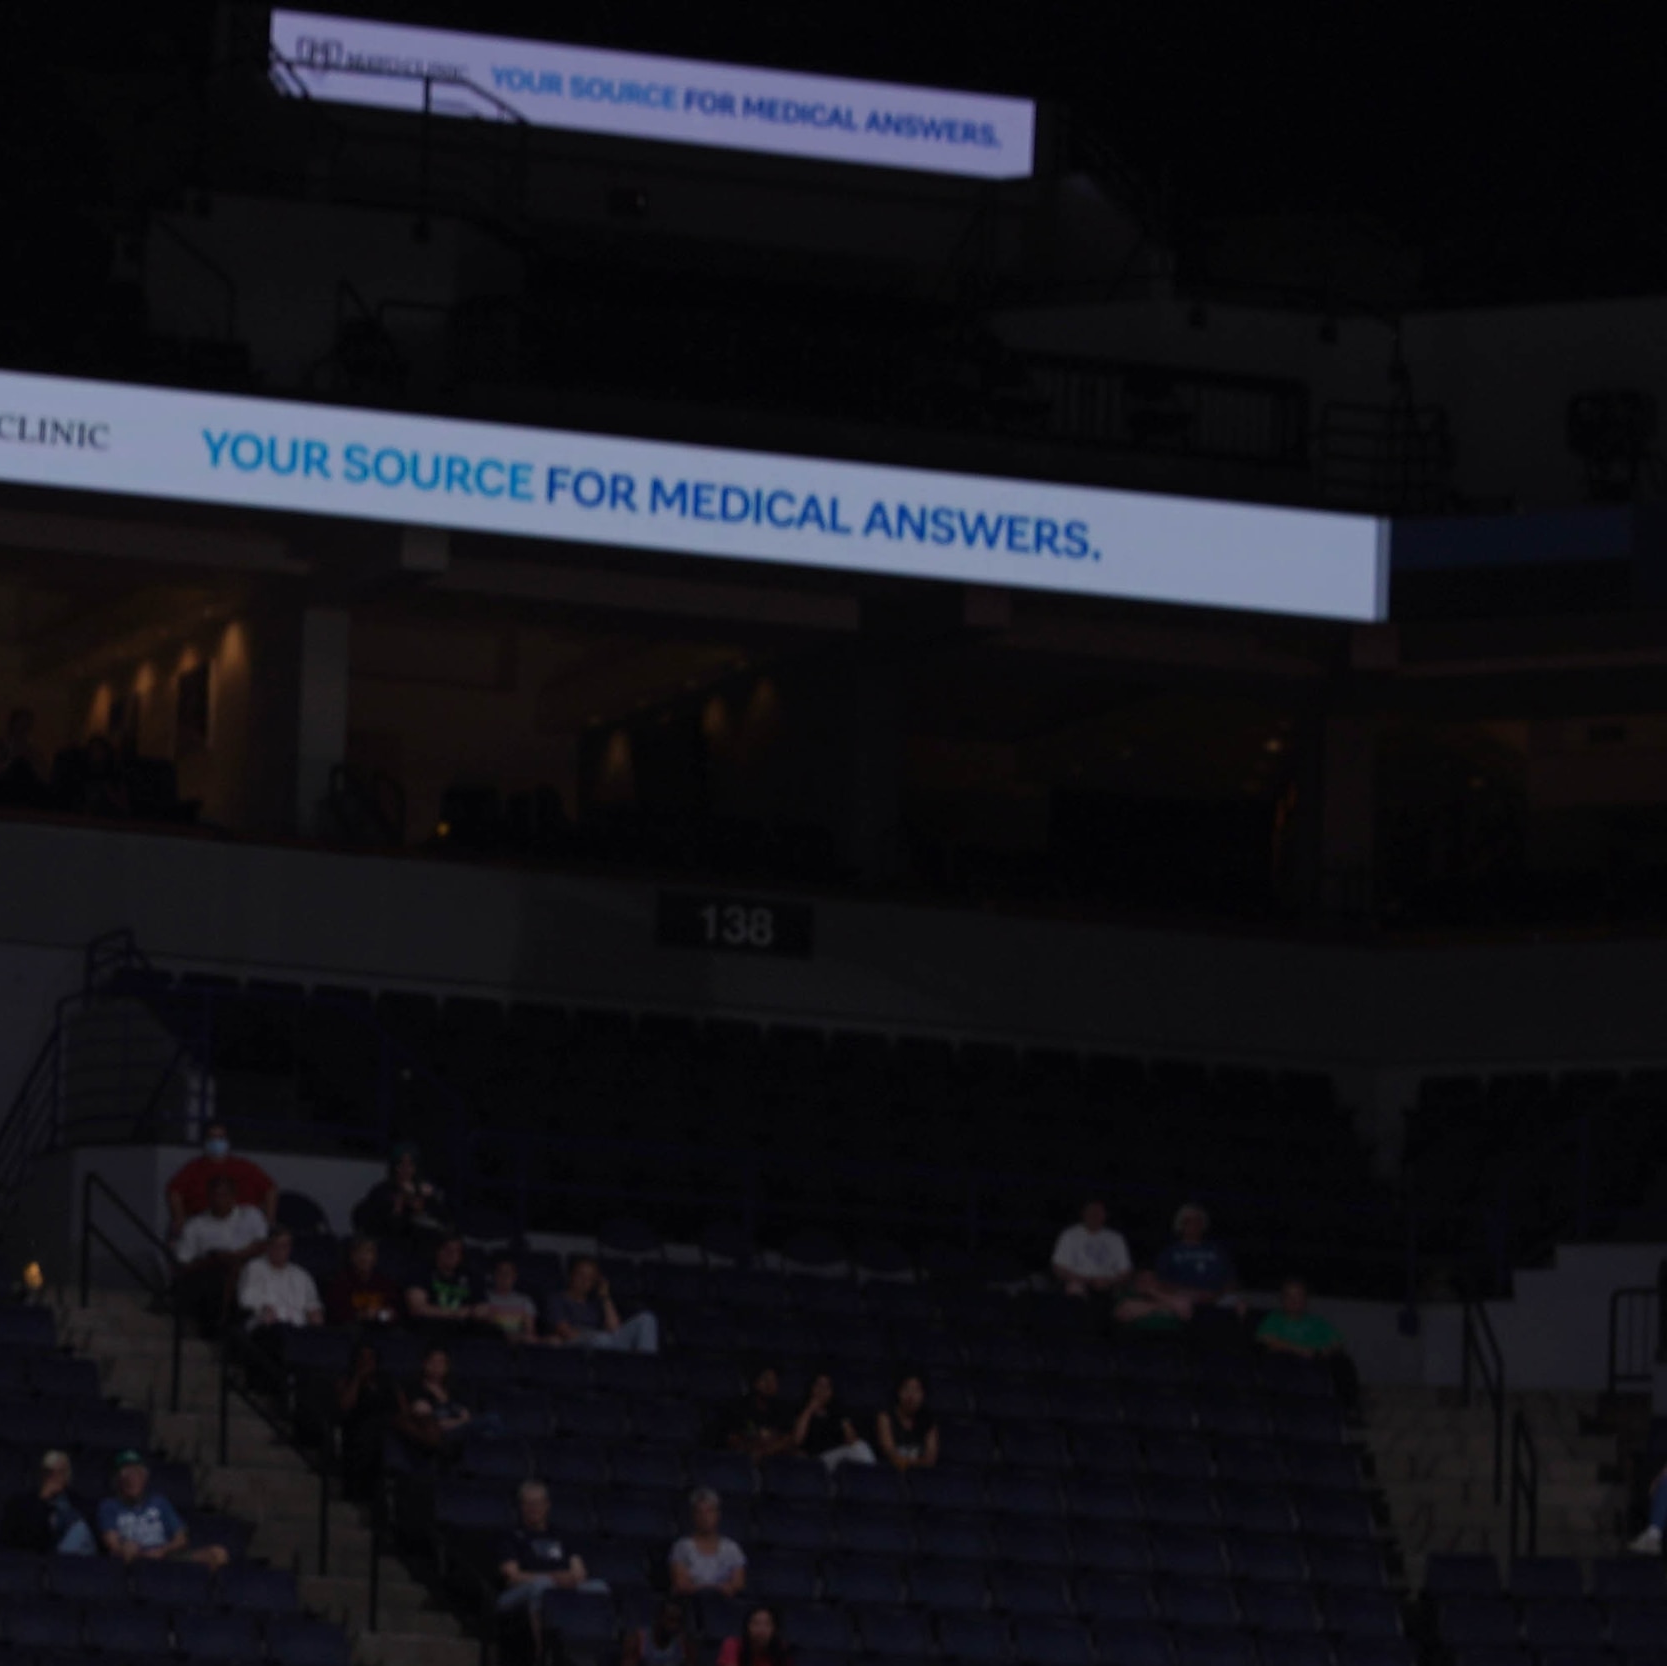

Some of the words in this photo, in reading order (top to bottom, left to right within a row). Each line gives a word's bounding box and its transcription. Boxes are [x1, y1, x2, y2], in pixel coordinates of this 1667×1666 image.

[491, 65, 564, 98] YOUR
[569, 74, 677, 111] SOURCE
[682, 86, 737, 118] FOR
[741, 95, 859, 133] MEDICAL
[864, 109, 1003, 150] ANSWERS.
[201, 427, 332, 481] YOUR
[342, 442, 536, 503] SOURCE
[545, 464, 639, 515] FOR
[648, 476, 853, 537] MEDICAL
[861, 500, 1103, 564] ANSWERS.
[698, 902, 775, 948] 138
